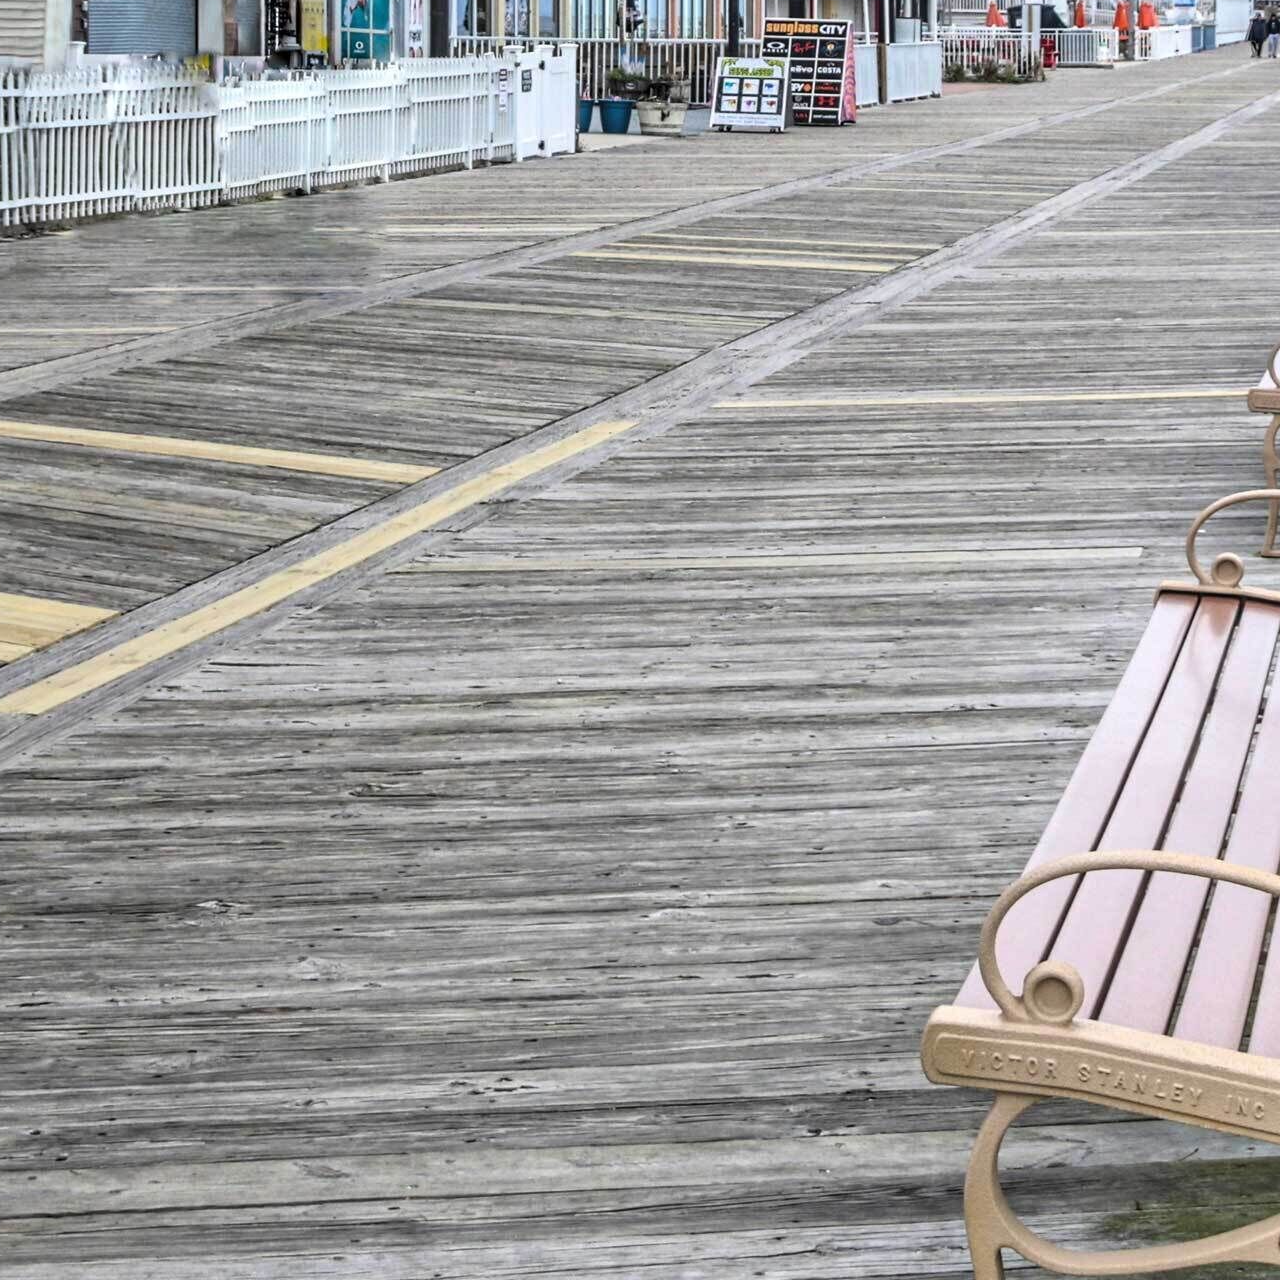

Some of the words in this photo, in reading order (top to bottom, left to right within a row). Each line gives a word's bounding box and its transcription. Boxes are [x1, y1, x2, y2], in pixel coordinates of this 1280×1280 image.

[817, 66, 841, 74] COSTA
[960, 1048, 1058, 1081] VICTOR
[1078, 1063, 1204, 1108] STANLEY
